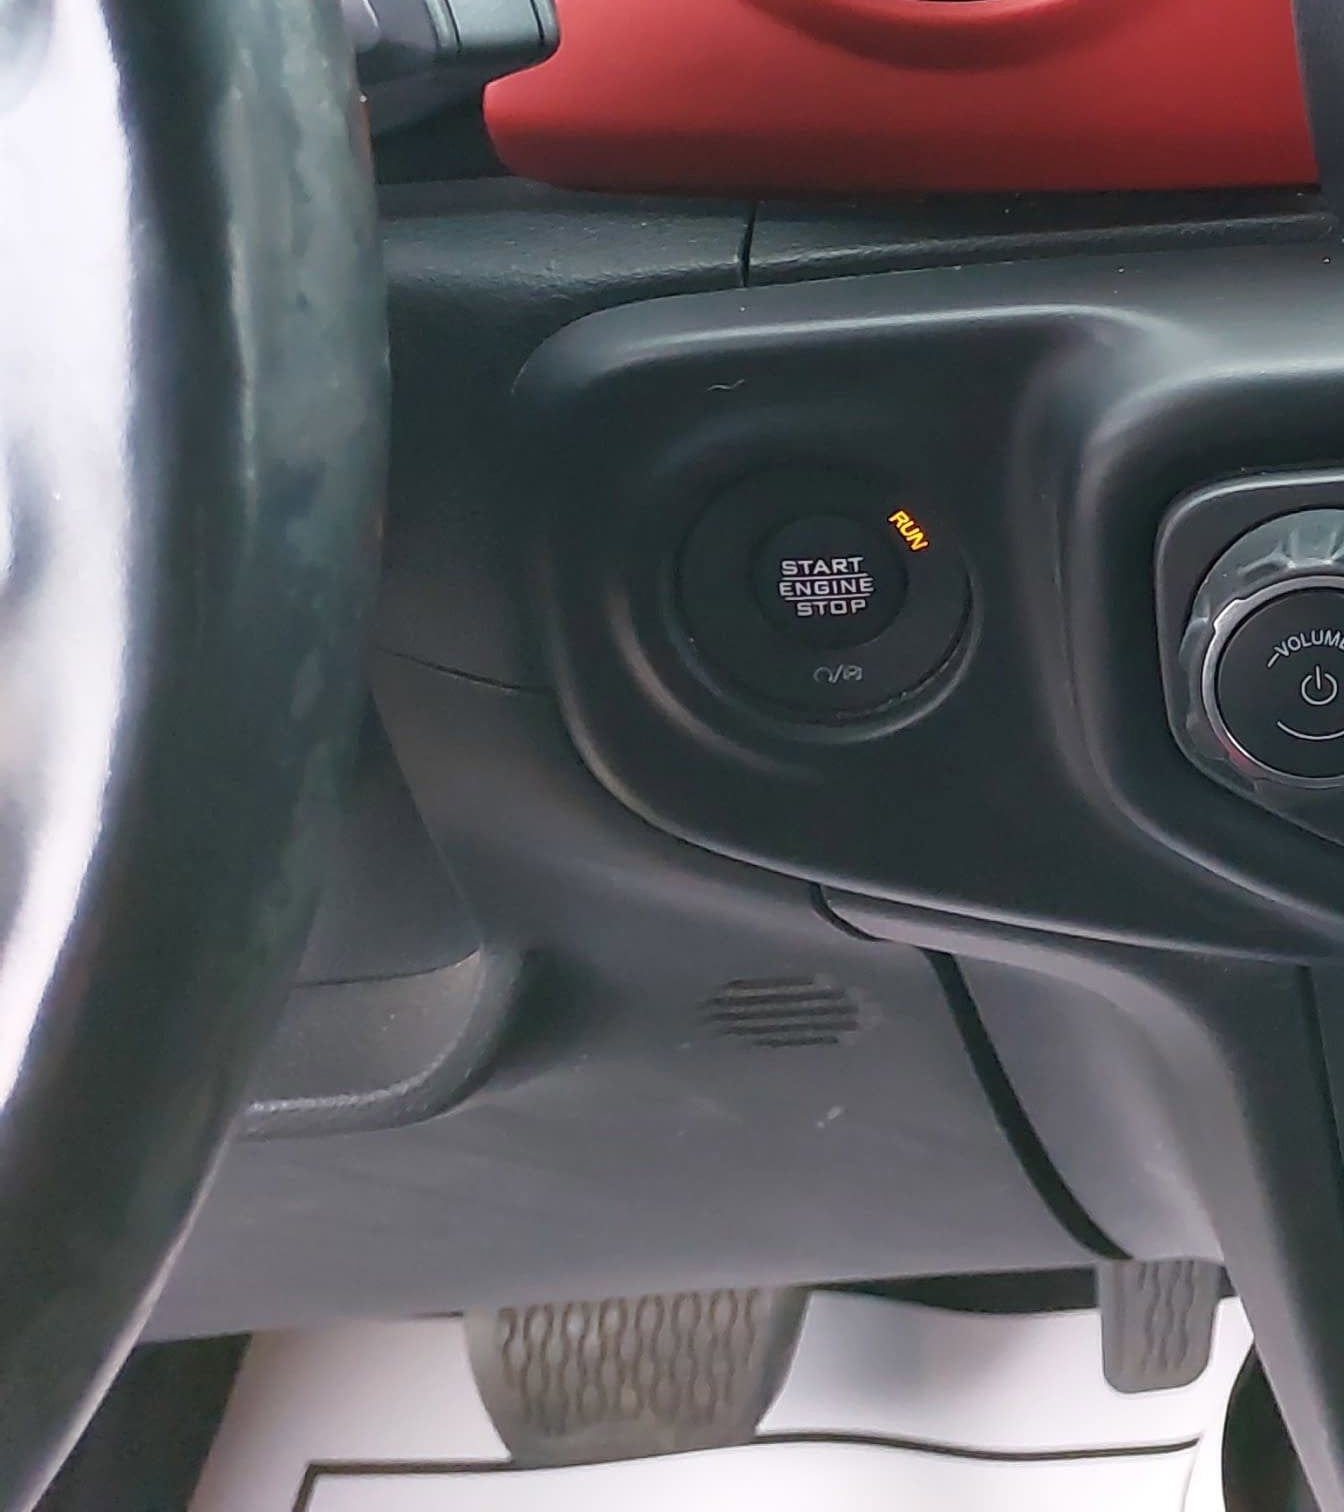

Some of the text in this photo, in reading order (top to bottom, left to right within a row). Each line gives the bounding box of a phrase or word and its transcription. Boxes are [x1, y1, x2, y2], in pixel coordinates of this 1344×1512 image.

[889, 510, 928, 551] RUN
[782, 557, 864, 575] START
[779, 578, 874, 596] ENGINE
[797, 599, 866, 616] STOP
